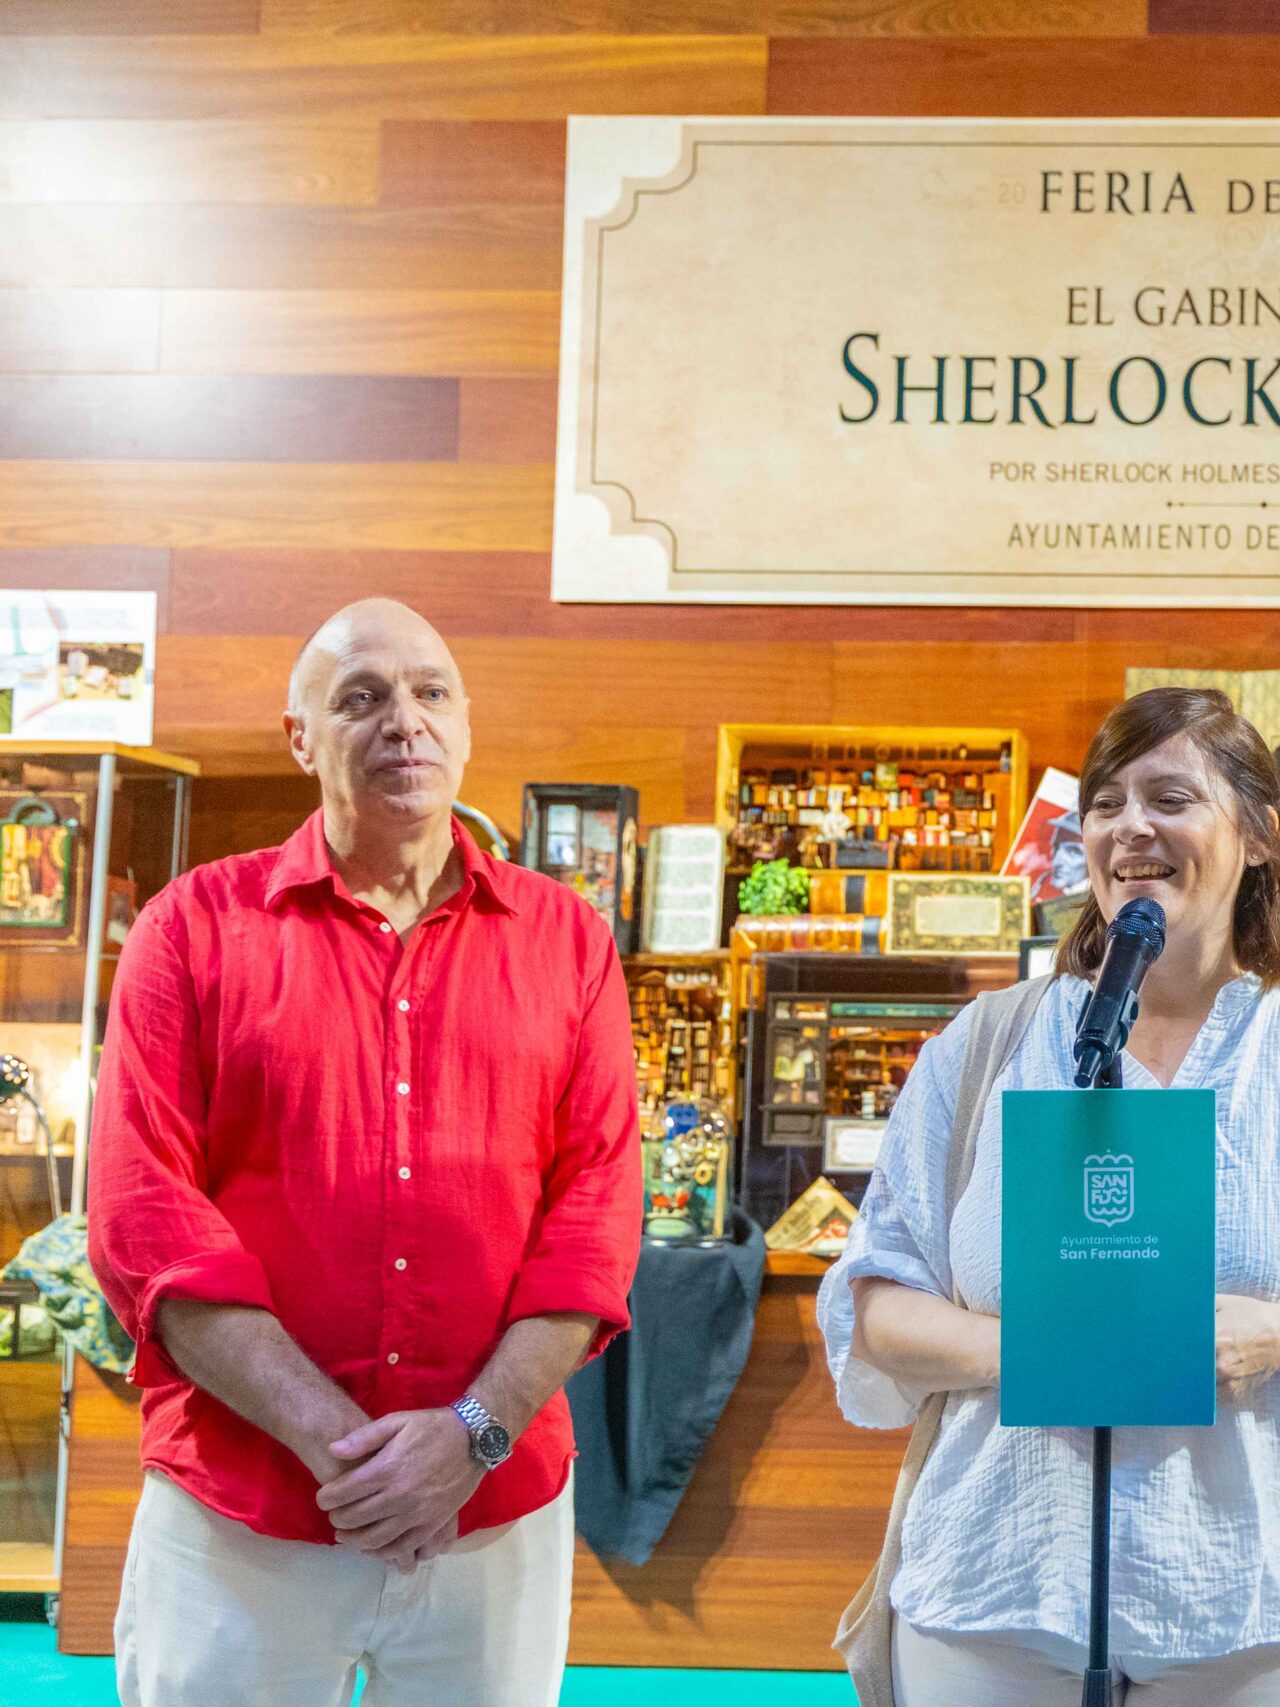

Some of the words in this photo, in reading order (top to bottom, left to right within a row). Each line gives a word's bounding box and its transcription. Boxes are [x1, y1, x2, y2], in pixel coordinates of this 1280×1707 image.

[1039, 170, 1196, 215] FERIA
[1067, 286, 1115, 326] EL
[989, 462, 1036, 482] POR
[1046, 462, 1172, 483] SHERLOCK
[1182, 463, 1280, 484] HOLMES
[1007, 523, 1232, 550] AYUNTAMIENTO
[1246, 524, 1279, 551] DE
[1091, 1174, 1127, 1188] SAN
[1061, 1235, 1141, 1247] Ayuntamiento
[1143, 1234, 1159, 1245] de
[1060, 1248, 1087, 1260] San
[1090, 1247, 1160, 1260] Fernando
